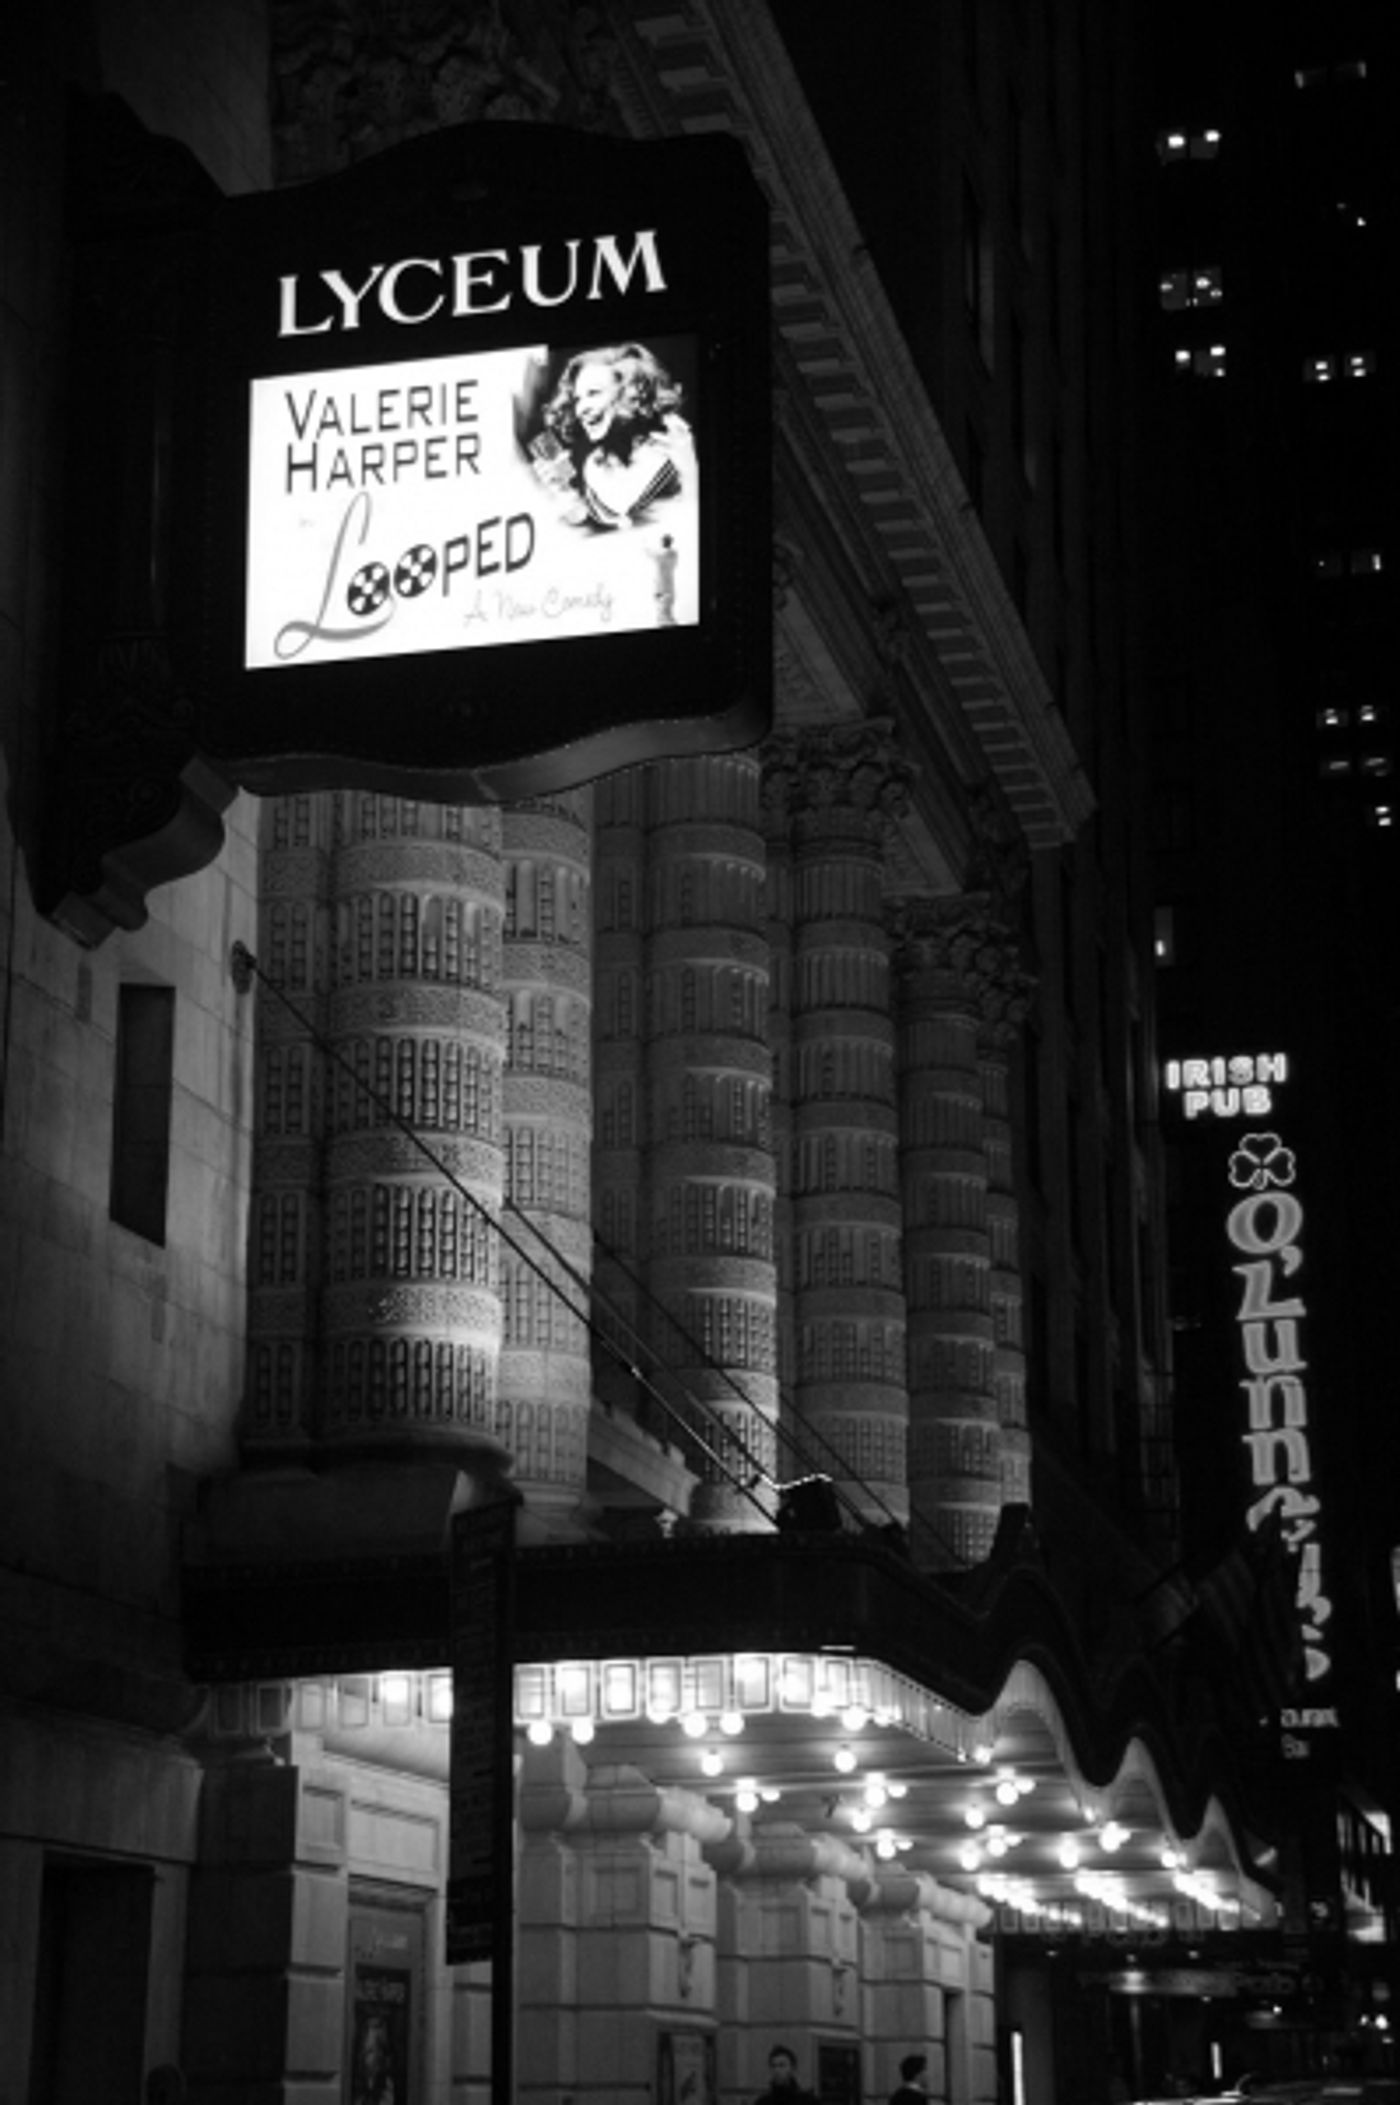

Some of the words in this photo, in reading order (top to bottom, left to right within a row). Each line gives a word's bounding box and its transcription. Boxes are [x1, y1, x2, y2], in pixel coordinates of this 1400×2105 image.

[278, 229, 667, 337] LYCEUM
[285, 379, 479, 441] VALERIE
[286, 432, 481, 494] HARPER
[463, 588, 489, 629] A
[1166, 1053, 1287, 1090] IRISH
[1184, 1084, 1272, 1119] PUB
